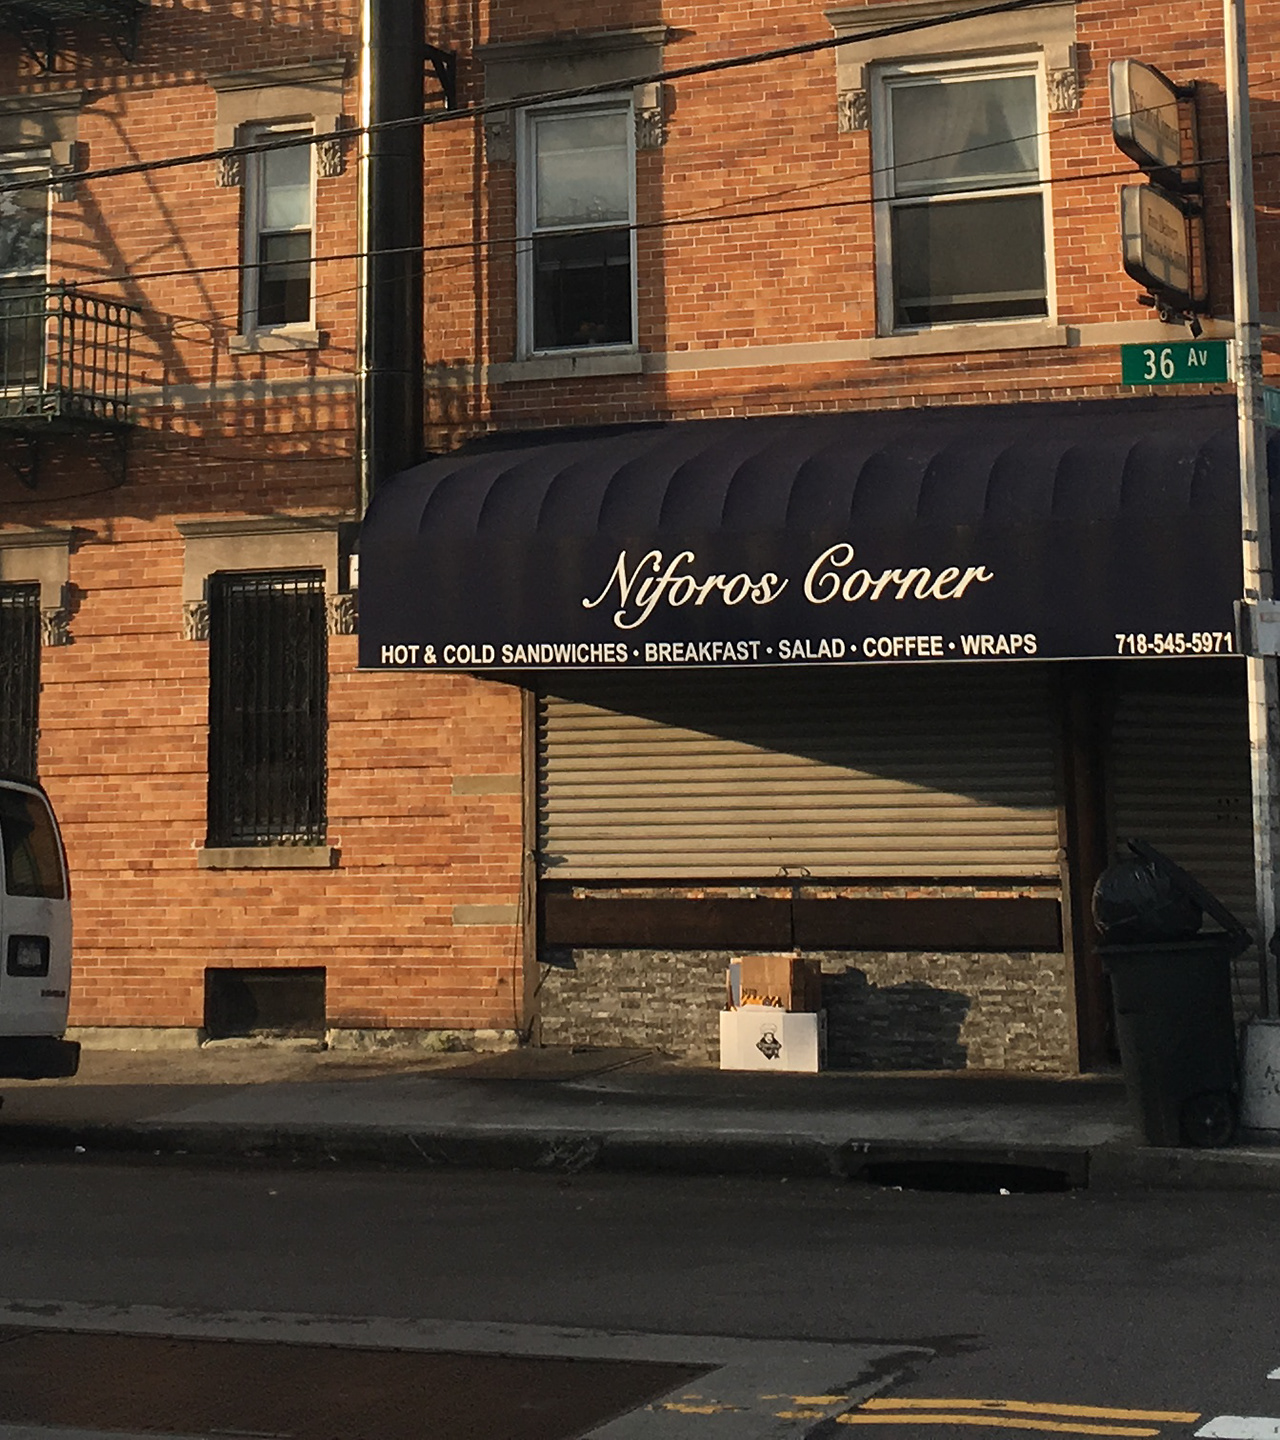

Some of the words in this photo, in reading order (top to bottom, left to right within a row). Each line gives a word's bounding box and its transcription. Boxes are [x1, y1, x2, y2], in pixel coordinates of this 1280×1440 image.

[1143, 348, 1175, 380] 36
[1187, 347, 1208, 367] Av
[582, 549, 789, 630] Niforos
[803, 542, 994, 604] Corner
[380, 644, 420, 665] HOT
[423, 644, 438, 665] &
[443, 644, 495, 664] COLD
[500, 642, 629, 664] SANDWICHES
[644, 640, 762, 663] BREAKFAST
[778, 638, 846, 660] SALAD
[862, 635, 945, 658] COFFEE
[960, 633, 1038, 656] WRAPS
[1114, 631, 1234, 655] 718-545-5971
